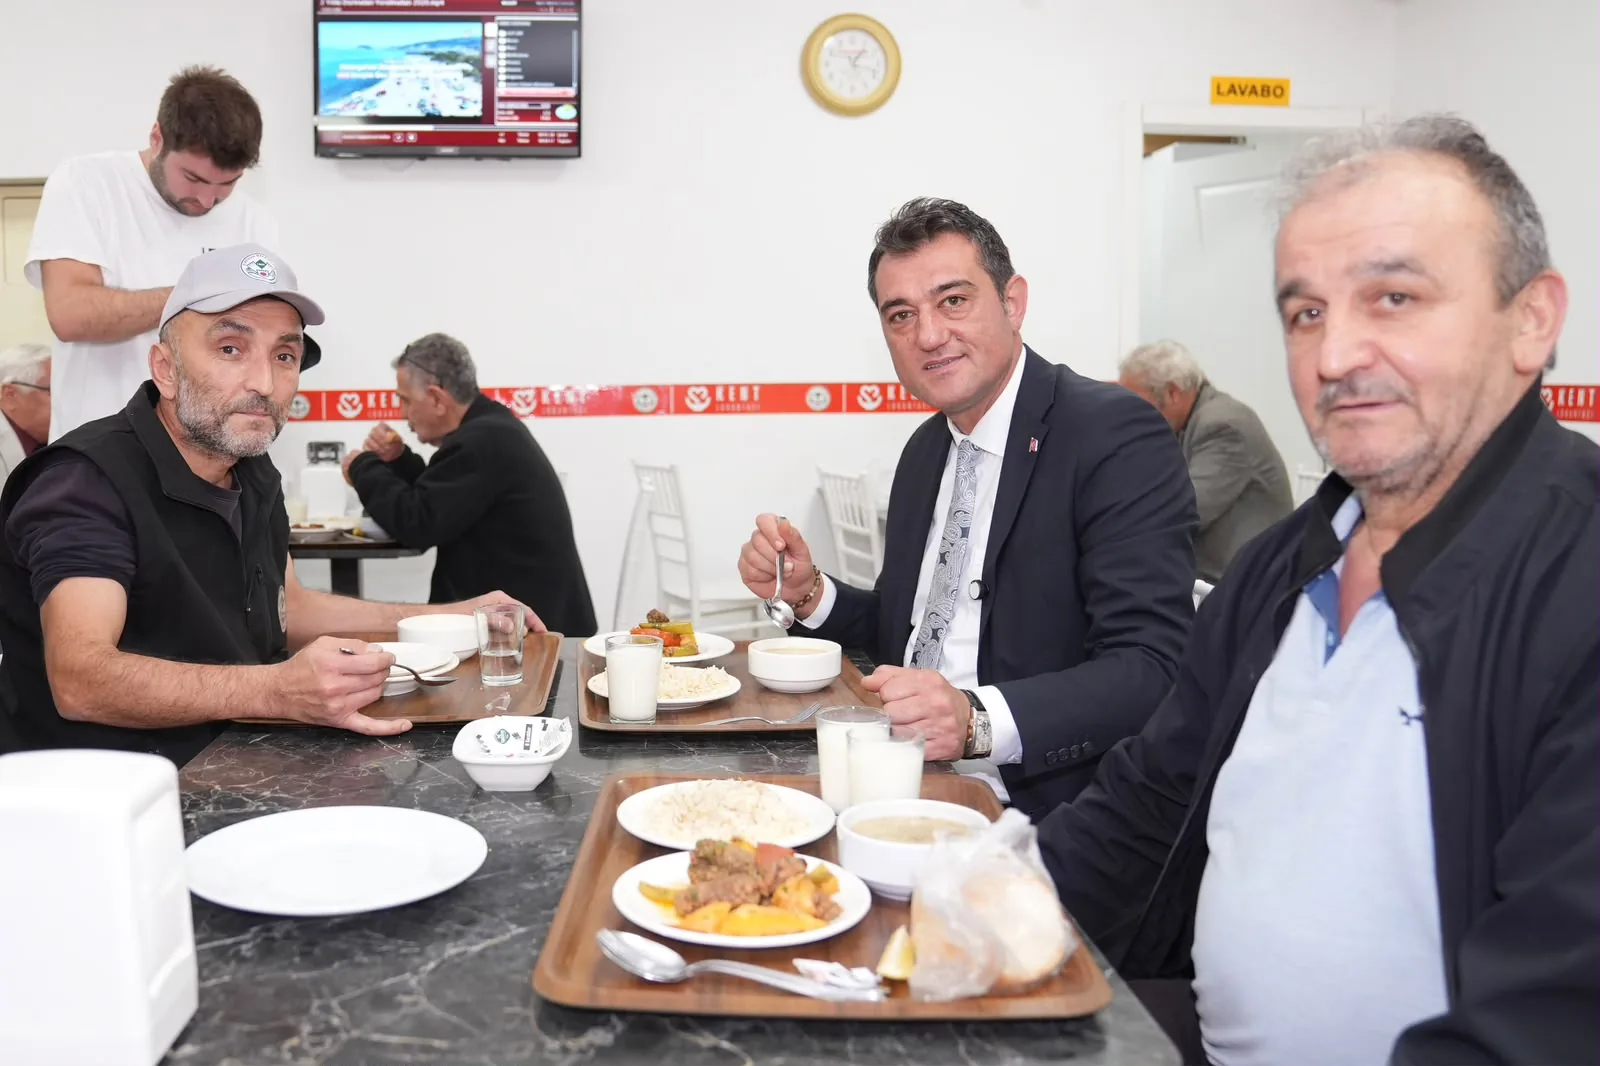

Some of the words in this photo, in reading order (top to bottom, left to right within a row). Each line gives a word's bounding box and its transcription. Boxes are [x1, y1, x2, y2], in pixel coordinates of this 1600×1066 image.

[1216, 83, 1285, 99] LAVABO
[367, 391, 400, 409] KEN
[715, 384, 760, 402] KENT
[887, 383, 919, 401] KE
[1558, 387, 1596, 407] KENT
